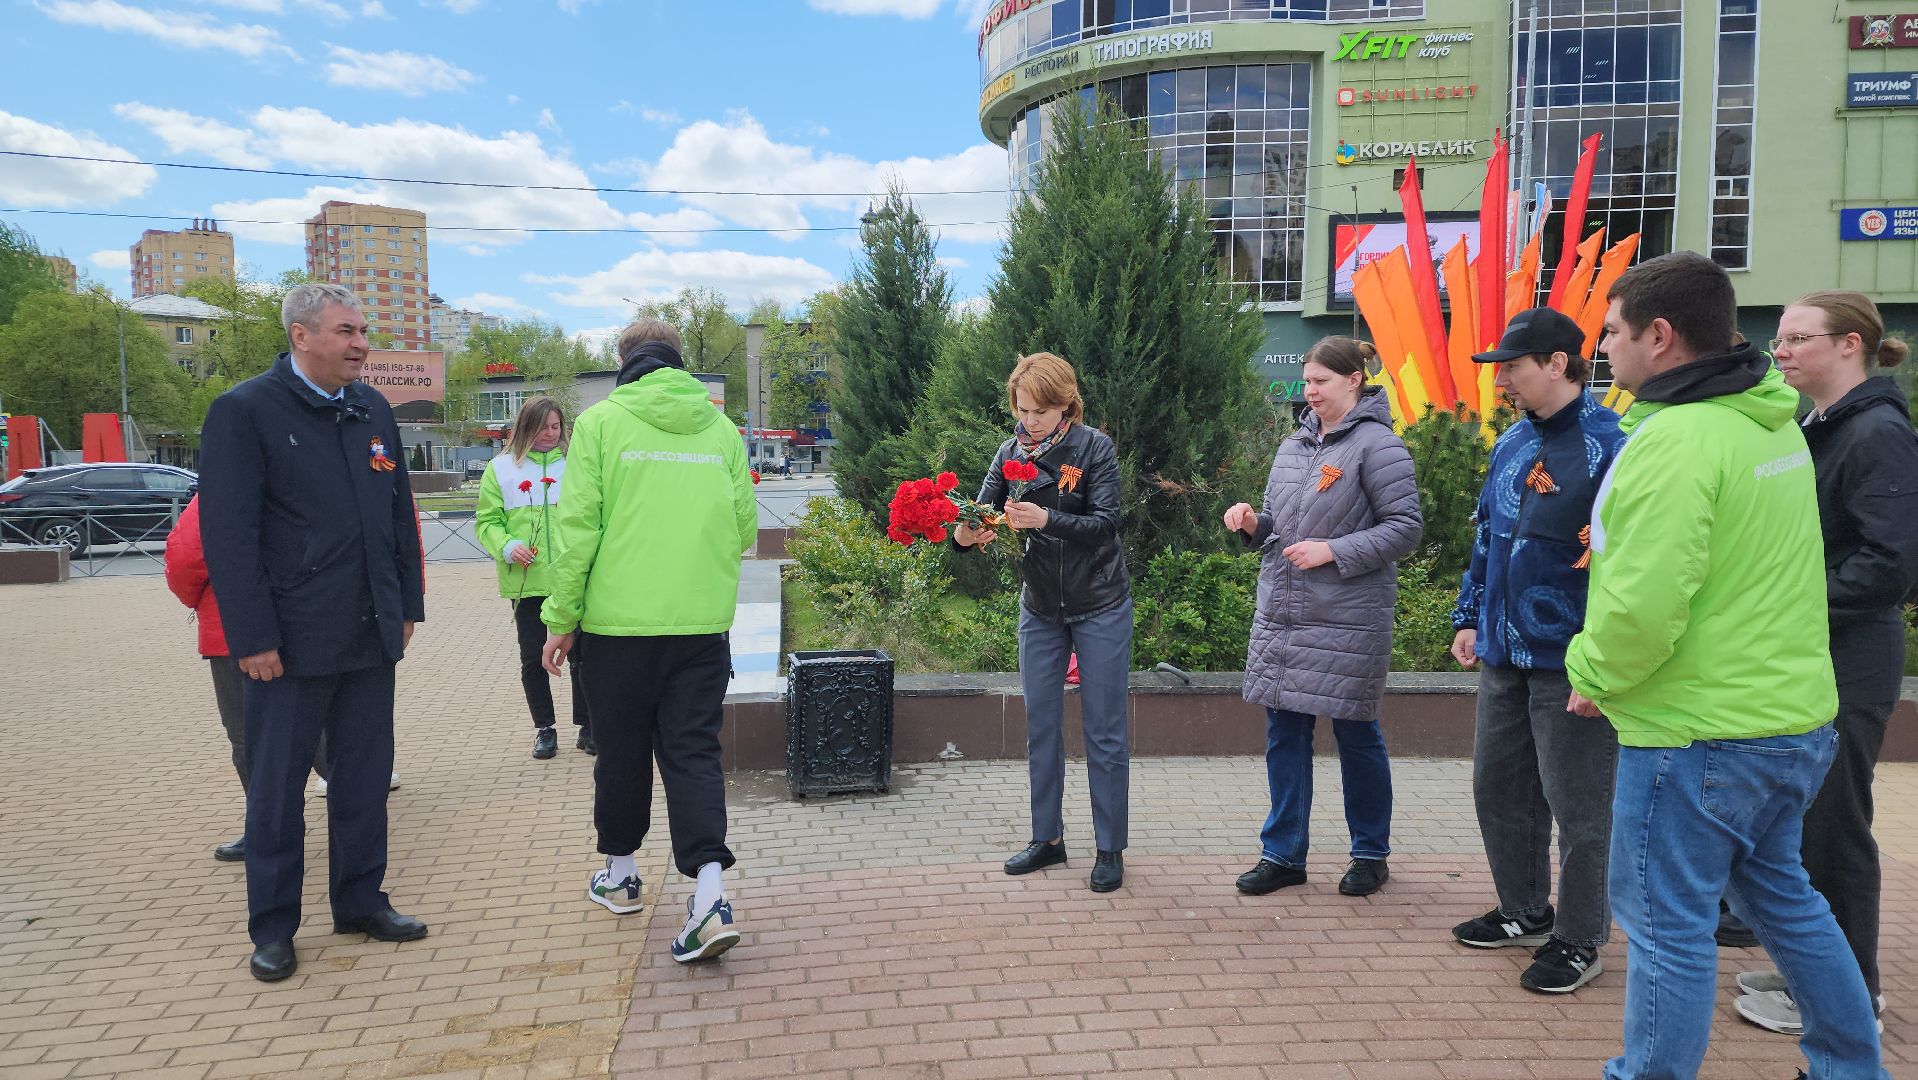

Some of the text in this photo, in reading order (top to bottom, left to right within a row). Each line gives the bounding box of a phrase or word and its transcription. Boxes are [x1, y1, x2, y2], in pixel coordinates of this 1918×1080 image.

[1094, 29, 1213, 62] ТИПОГРАФИЯ
[1024, 50, 1079, 79] РЕСТОРАН
[1362, 84, 1479, 102] SUNLIGHT
[1853, 80, 1912, 92] ТРИУМФ
[1359, 140, 1477, 158] КОРАБЛИК
[1894, 219, 1918, 227] ИНО
[358, 376, 432, 388] П-КЛАССИК.РФ
